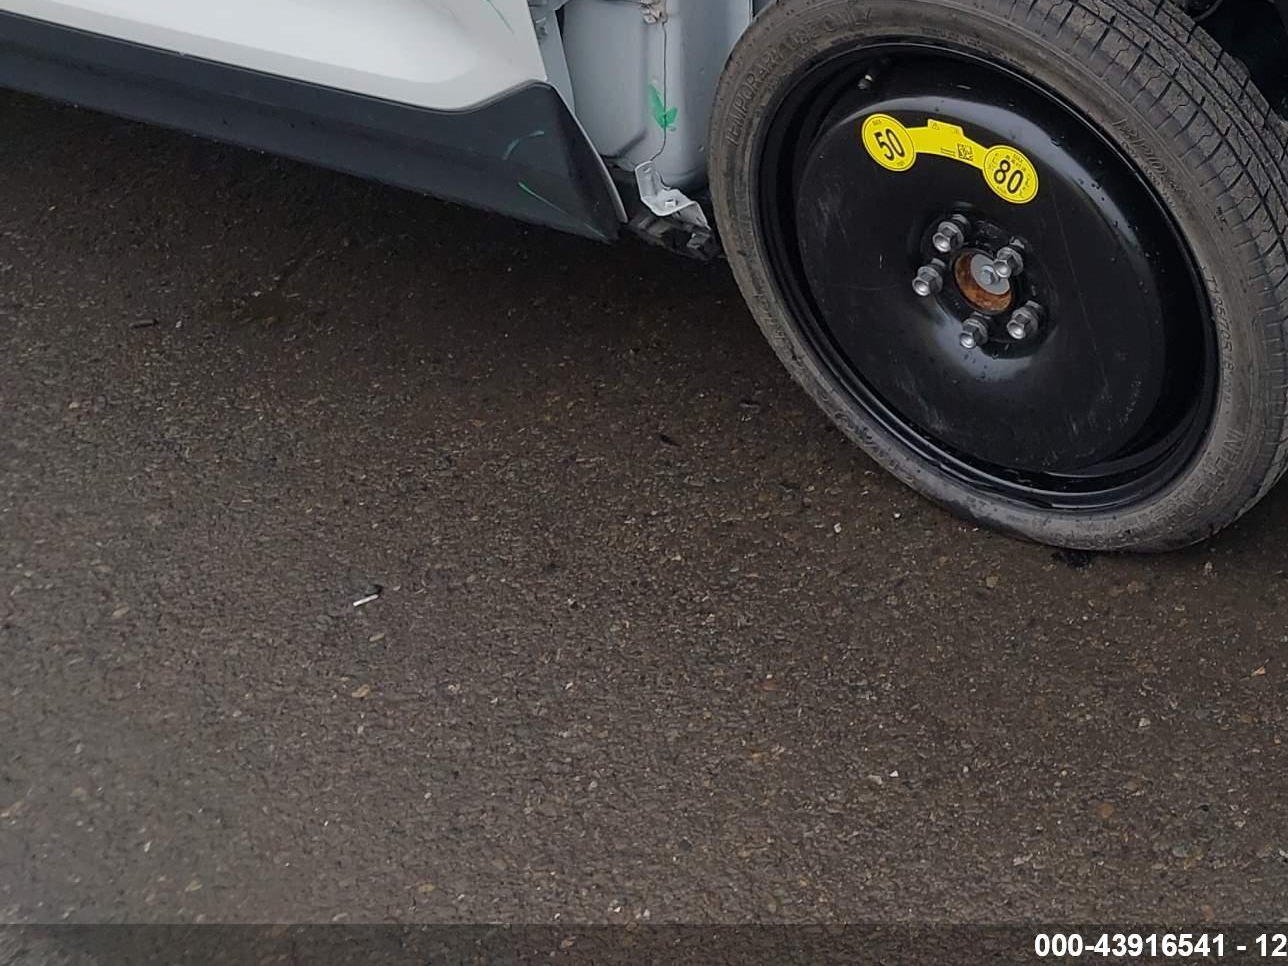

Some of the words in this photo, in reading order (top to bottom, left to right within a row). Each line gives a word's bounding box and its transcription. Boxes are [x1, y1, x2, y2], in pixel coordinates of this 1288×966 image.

[724, 45, 784, 148] TEMPORARY
[874, 128, 906, 161] 50
[993, 159, 1024, 194] 80
